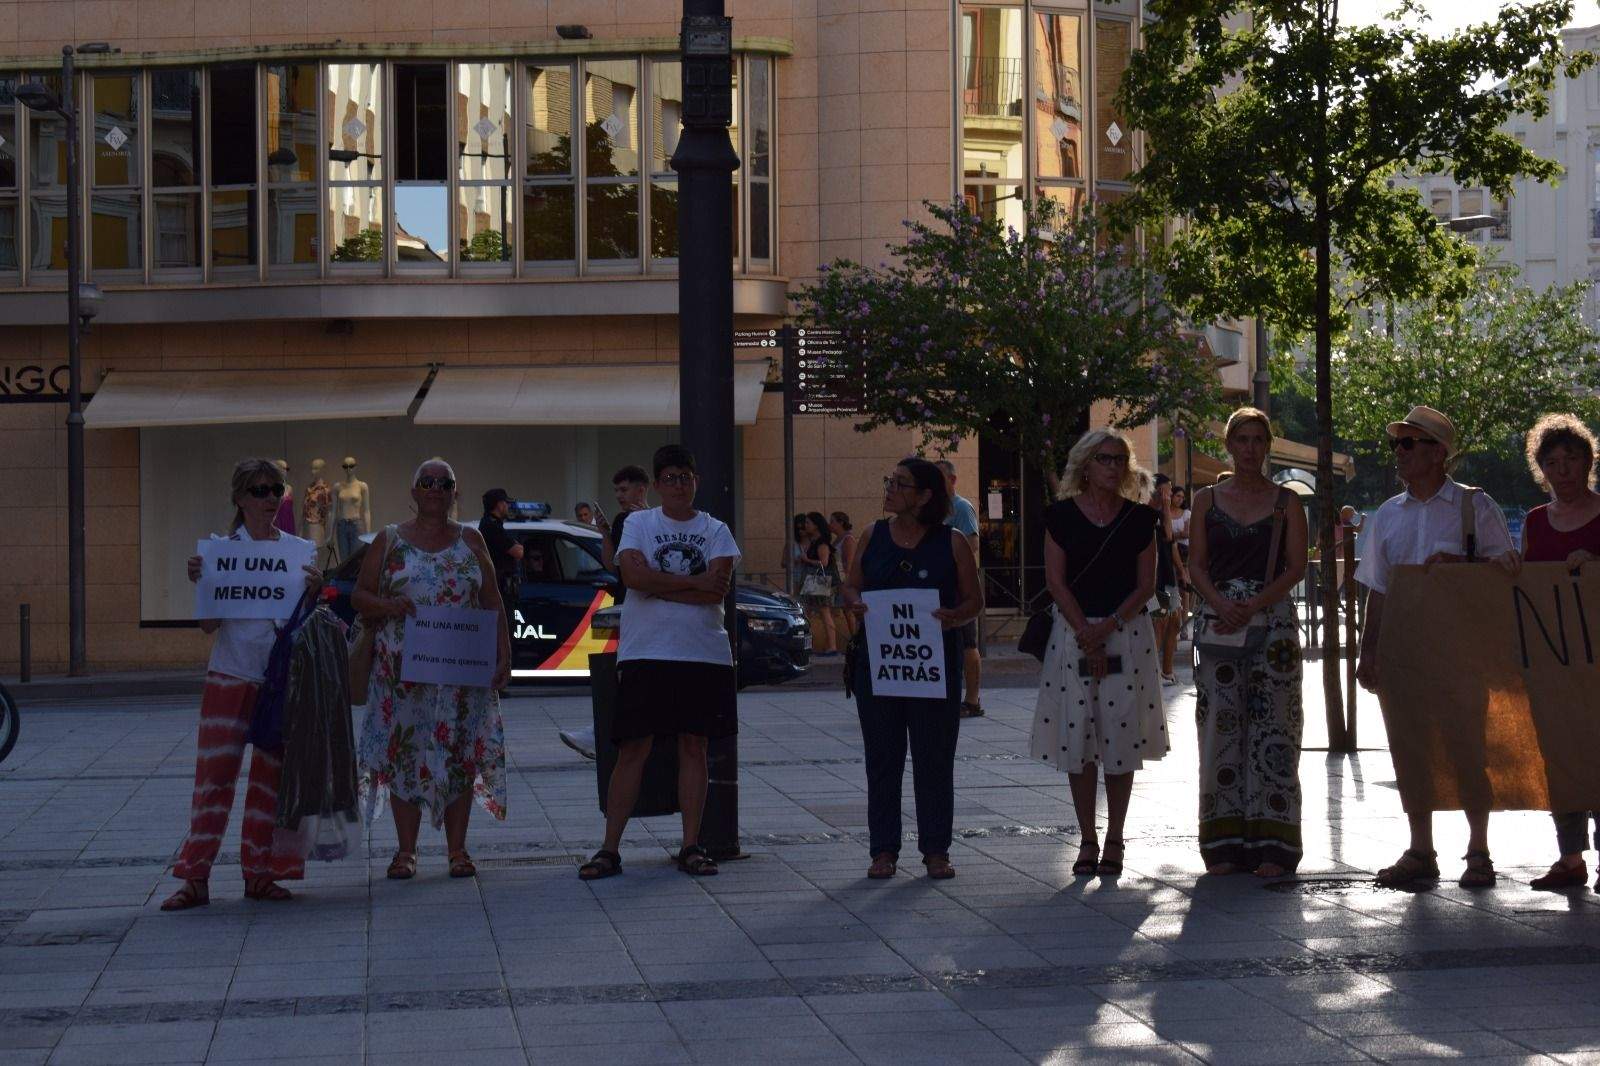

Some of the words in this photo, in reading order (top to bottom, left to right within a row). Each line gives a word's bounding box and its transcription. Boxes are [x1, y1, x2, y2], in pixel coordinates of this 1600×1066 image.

[217, 557, 237, 571] NI
[244, 557, 288, 572] UNA
[214, 585, 286, 600] MENOS
[892, 603, 914, 619] NI
[415, 619, 431, 629] #NI
[433, 621, 452, 630] UNA
[453, 623, 480, 632] MENOS
[890, 623, 920, 639] UN
[1512, 582, 1594, 668] NI
[412, 653, 440, 663] #Vivas
[442, 657, 456, 665] nos
[880, 643, 933, 660] PASO
[877, 662, 941, 682] ATRÁS
